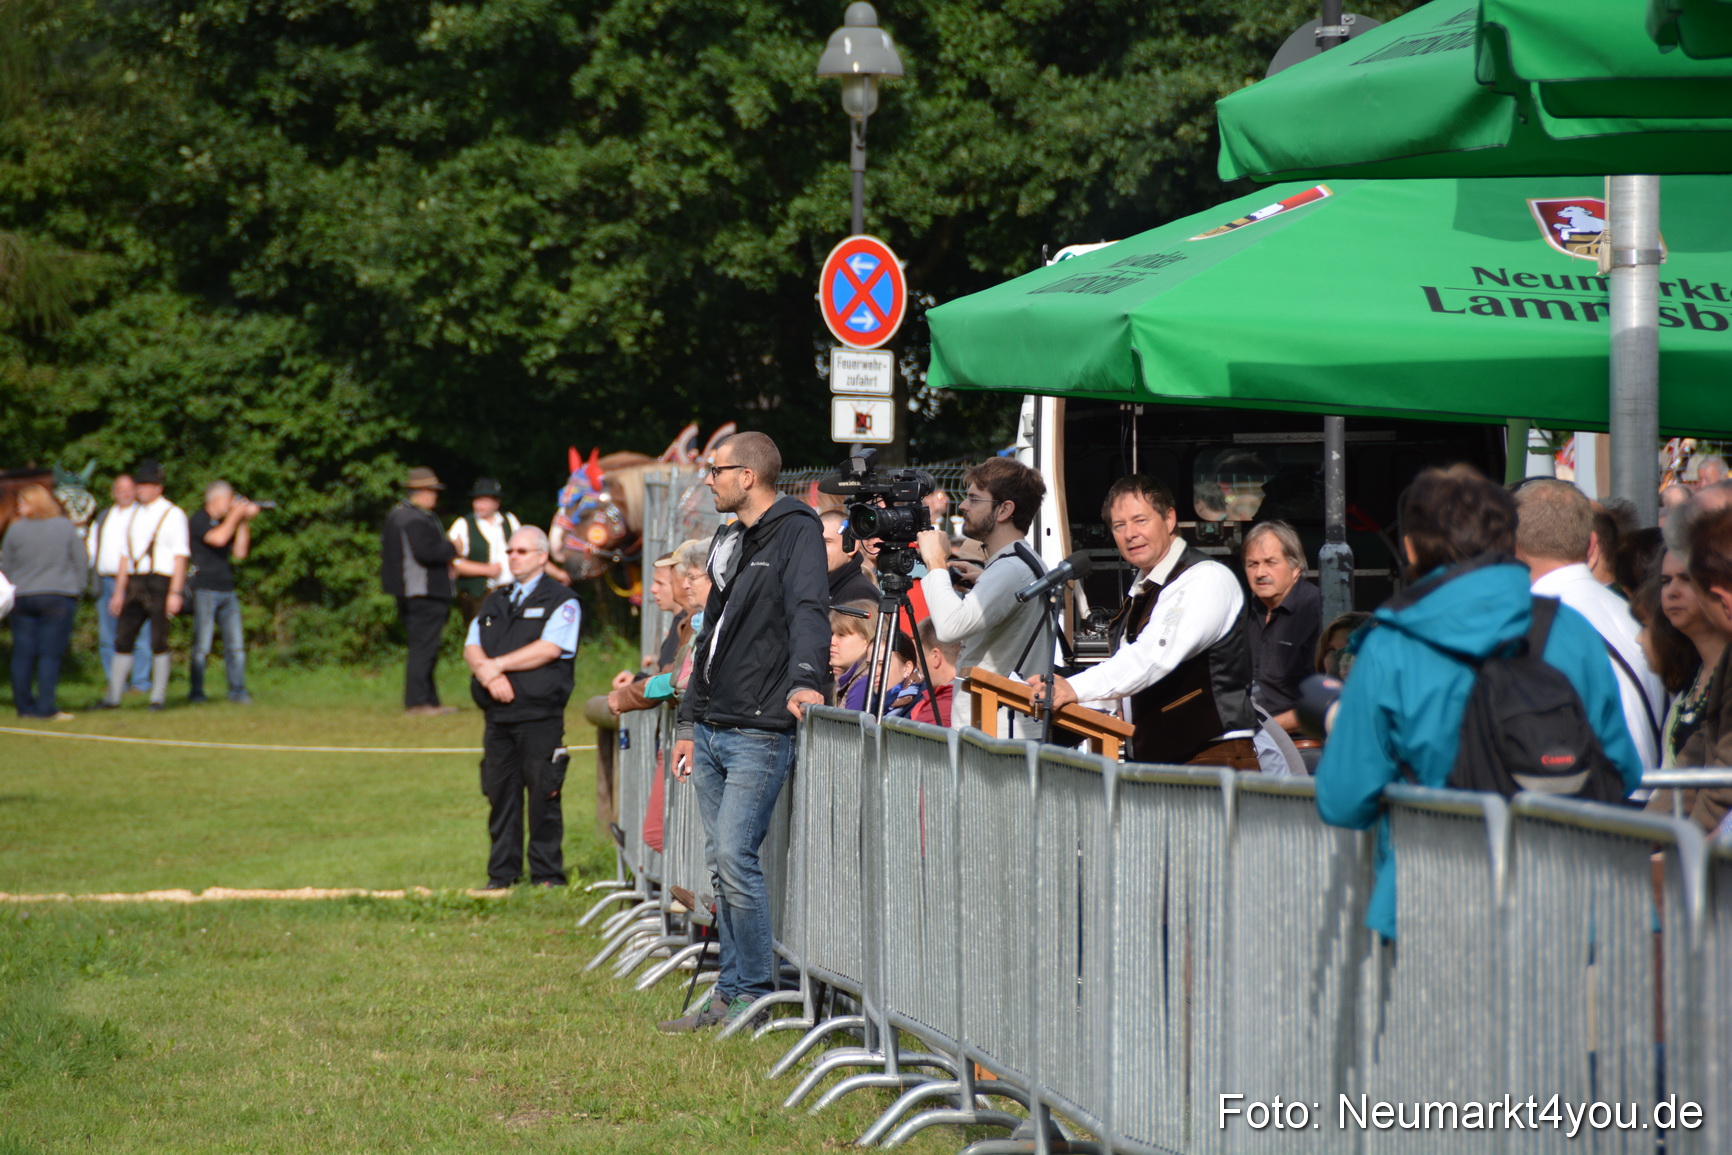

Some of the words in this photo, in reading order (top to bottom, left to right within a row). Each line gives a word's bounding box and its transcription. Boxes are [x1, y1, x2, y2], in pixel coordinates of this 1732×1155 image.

[1471, 266, 1732, 303] Neumrkt
[837, 356, 887, 371] Feuerwehr-
[846, 375, 878, 387] zufahrt
[1541, 754, 1573, 766] Canon
